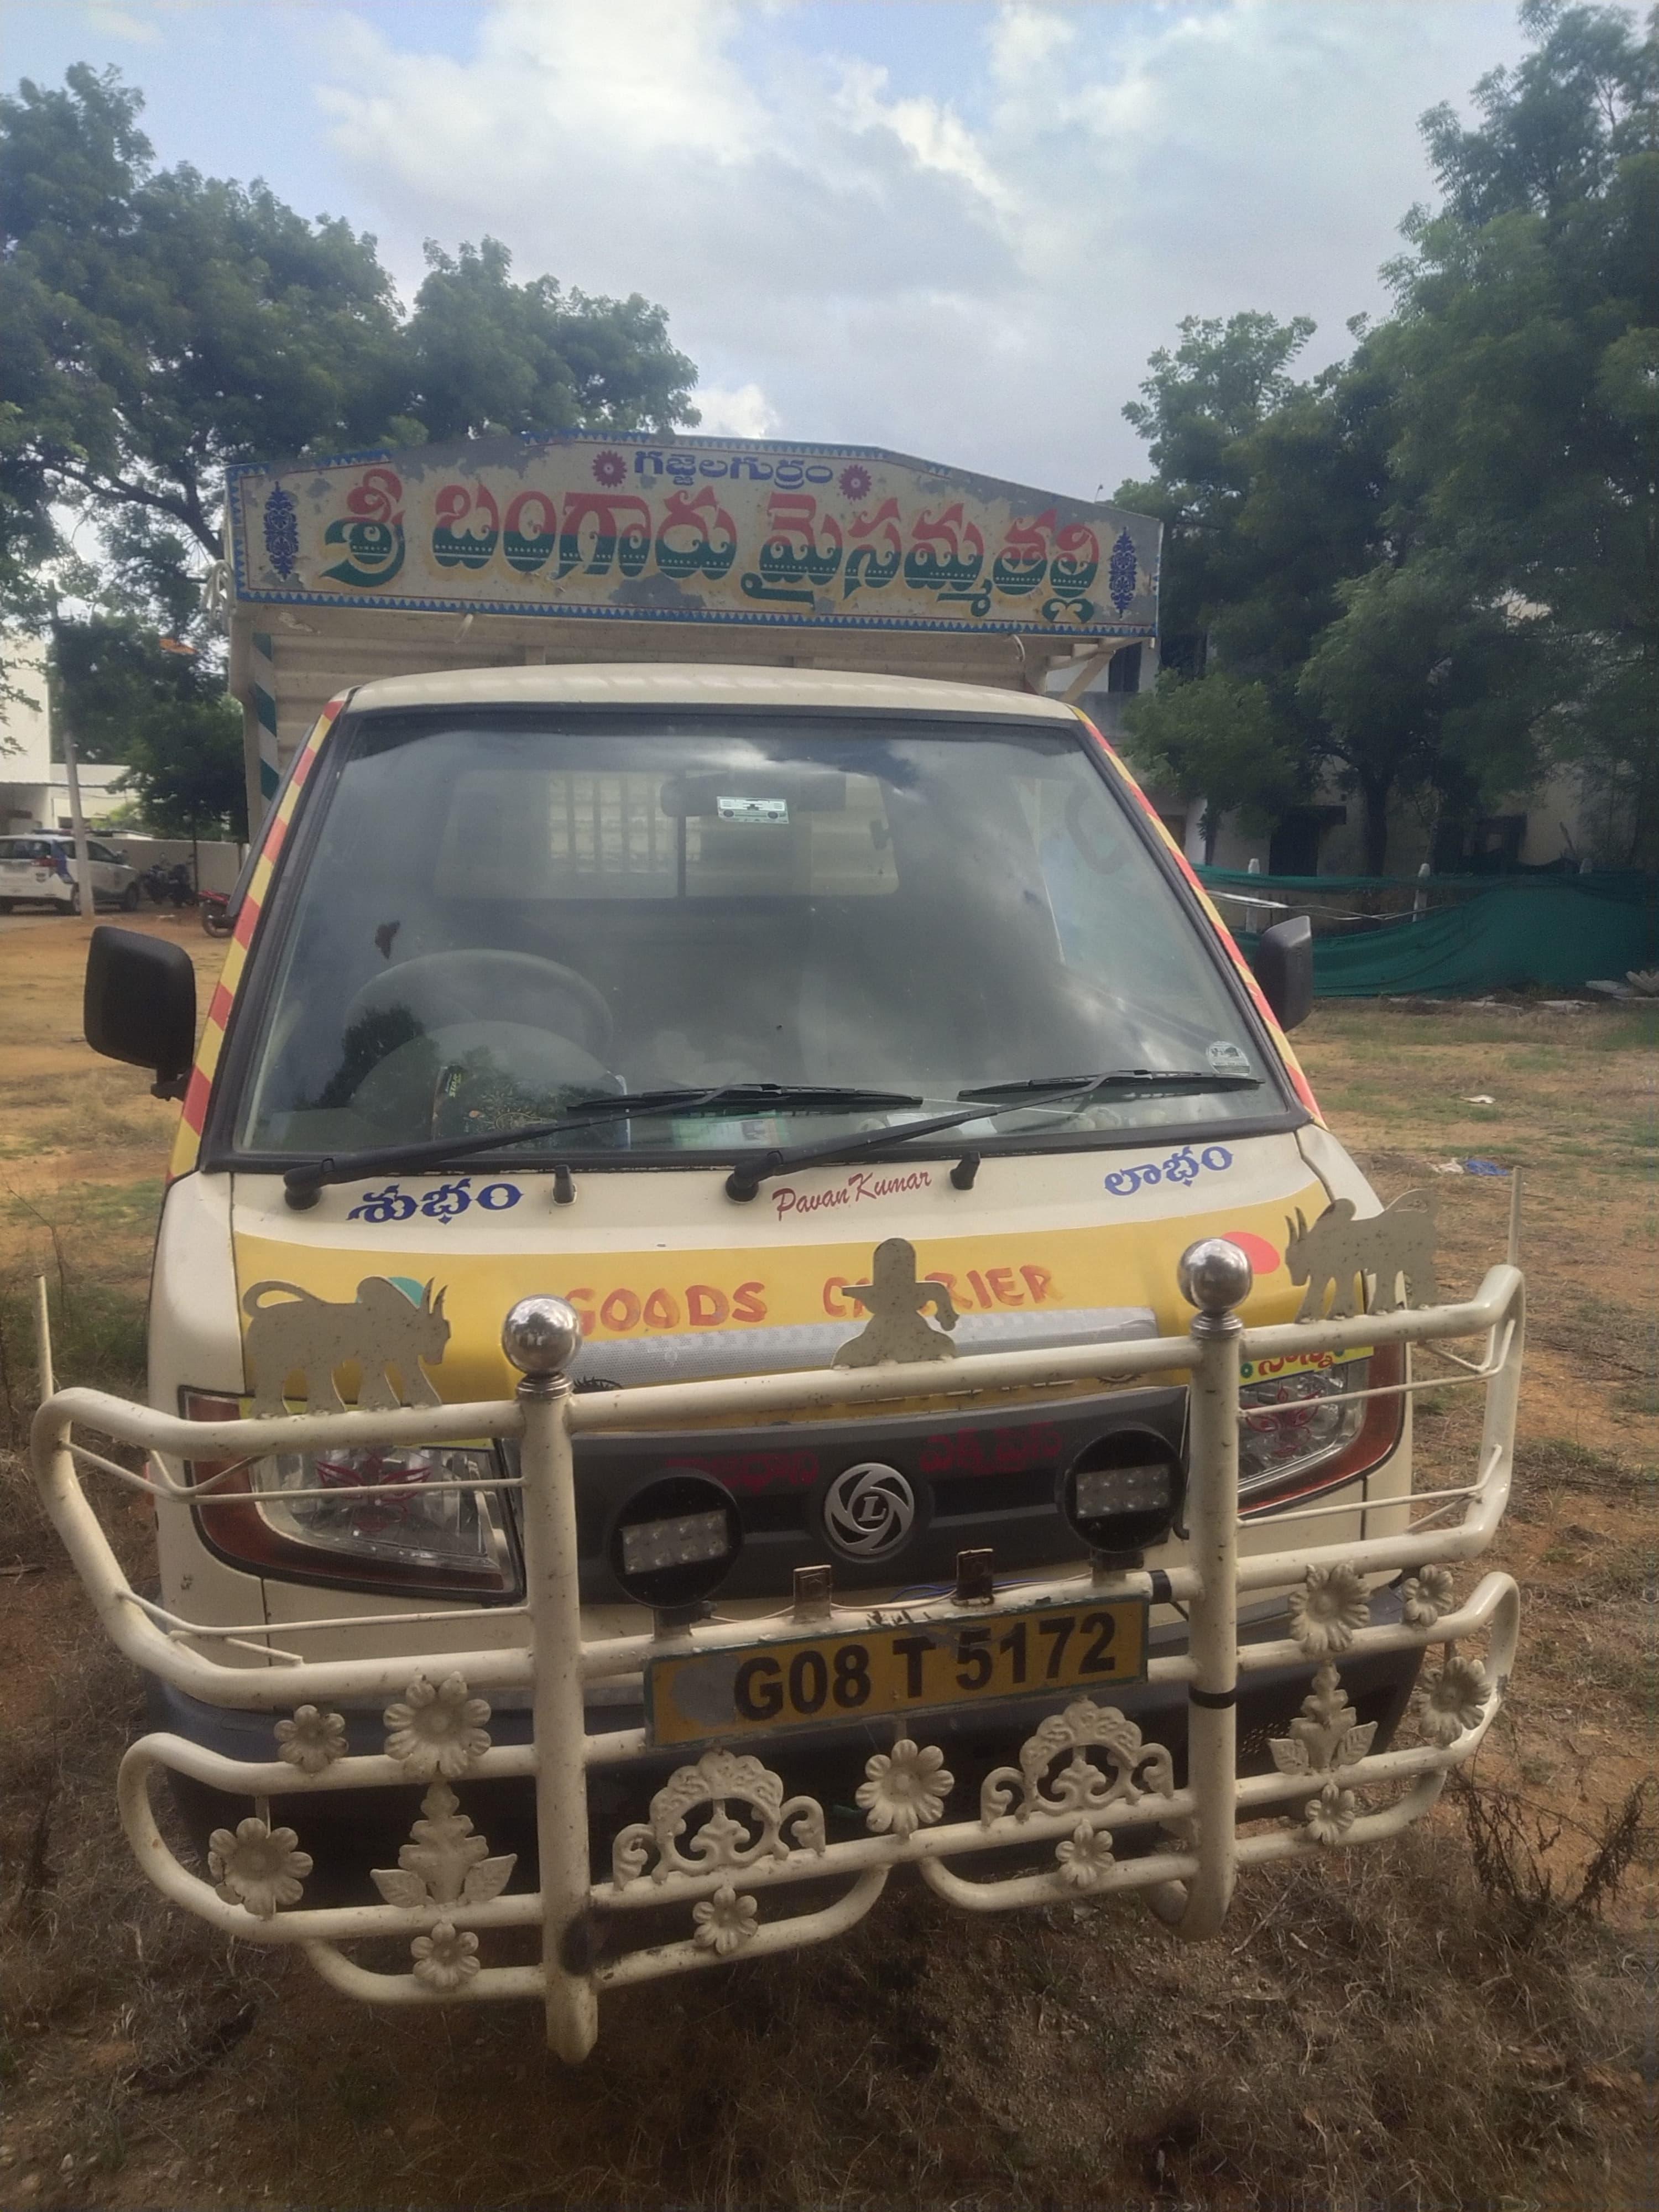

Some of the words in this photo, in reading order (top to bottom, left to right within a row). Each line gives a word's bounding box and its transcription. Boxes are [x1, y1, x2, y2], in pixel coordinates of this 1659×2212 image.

[319, 468, 405, 588] శ్రీ
[432, 478, 738, 581] బంగారు
[347, 1178, 524, 1224] శుభం
[1104, 1146, 1234, 1196] లాభం
[565, 1281, 768, 1337] GOODS
[823, 1264, 1065, 1318] CRIER
[893, 1636, 936, 1699] T
[955, 1611, 1117, 1691] 5172
